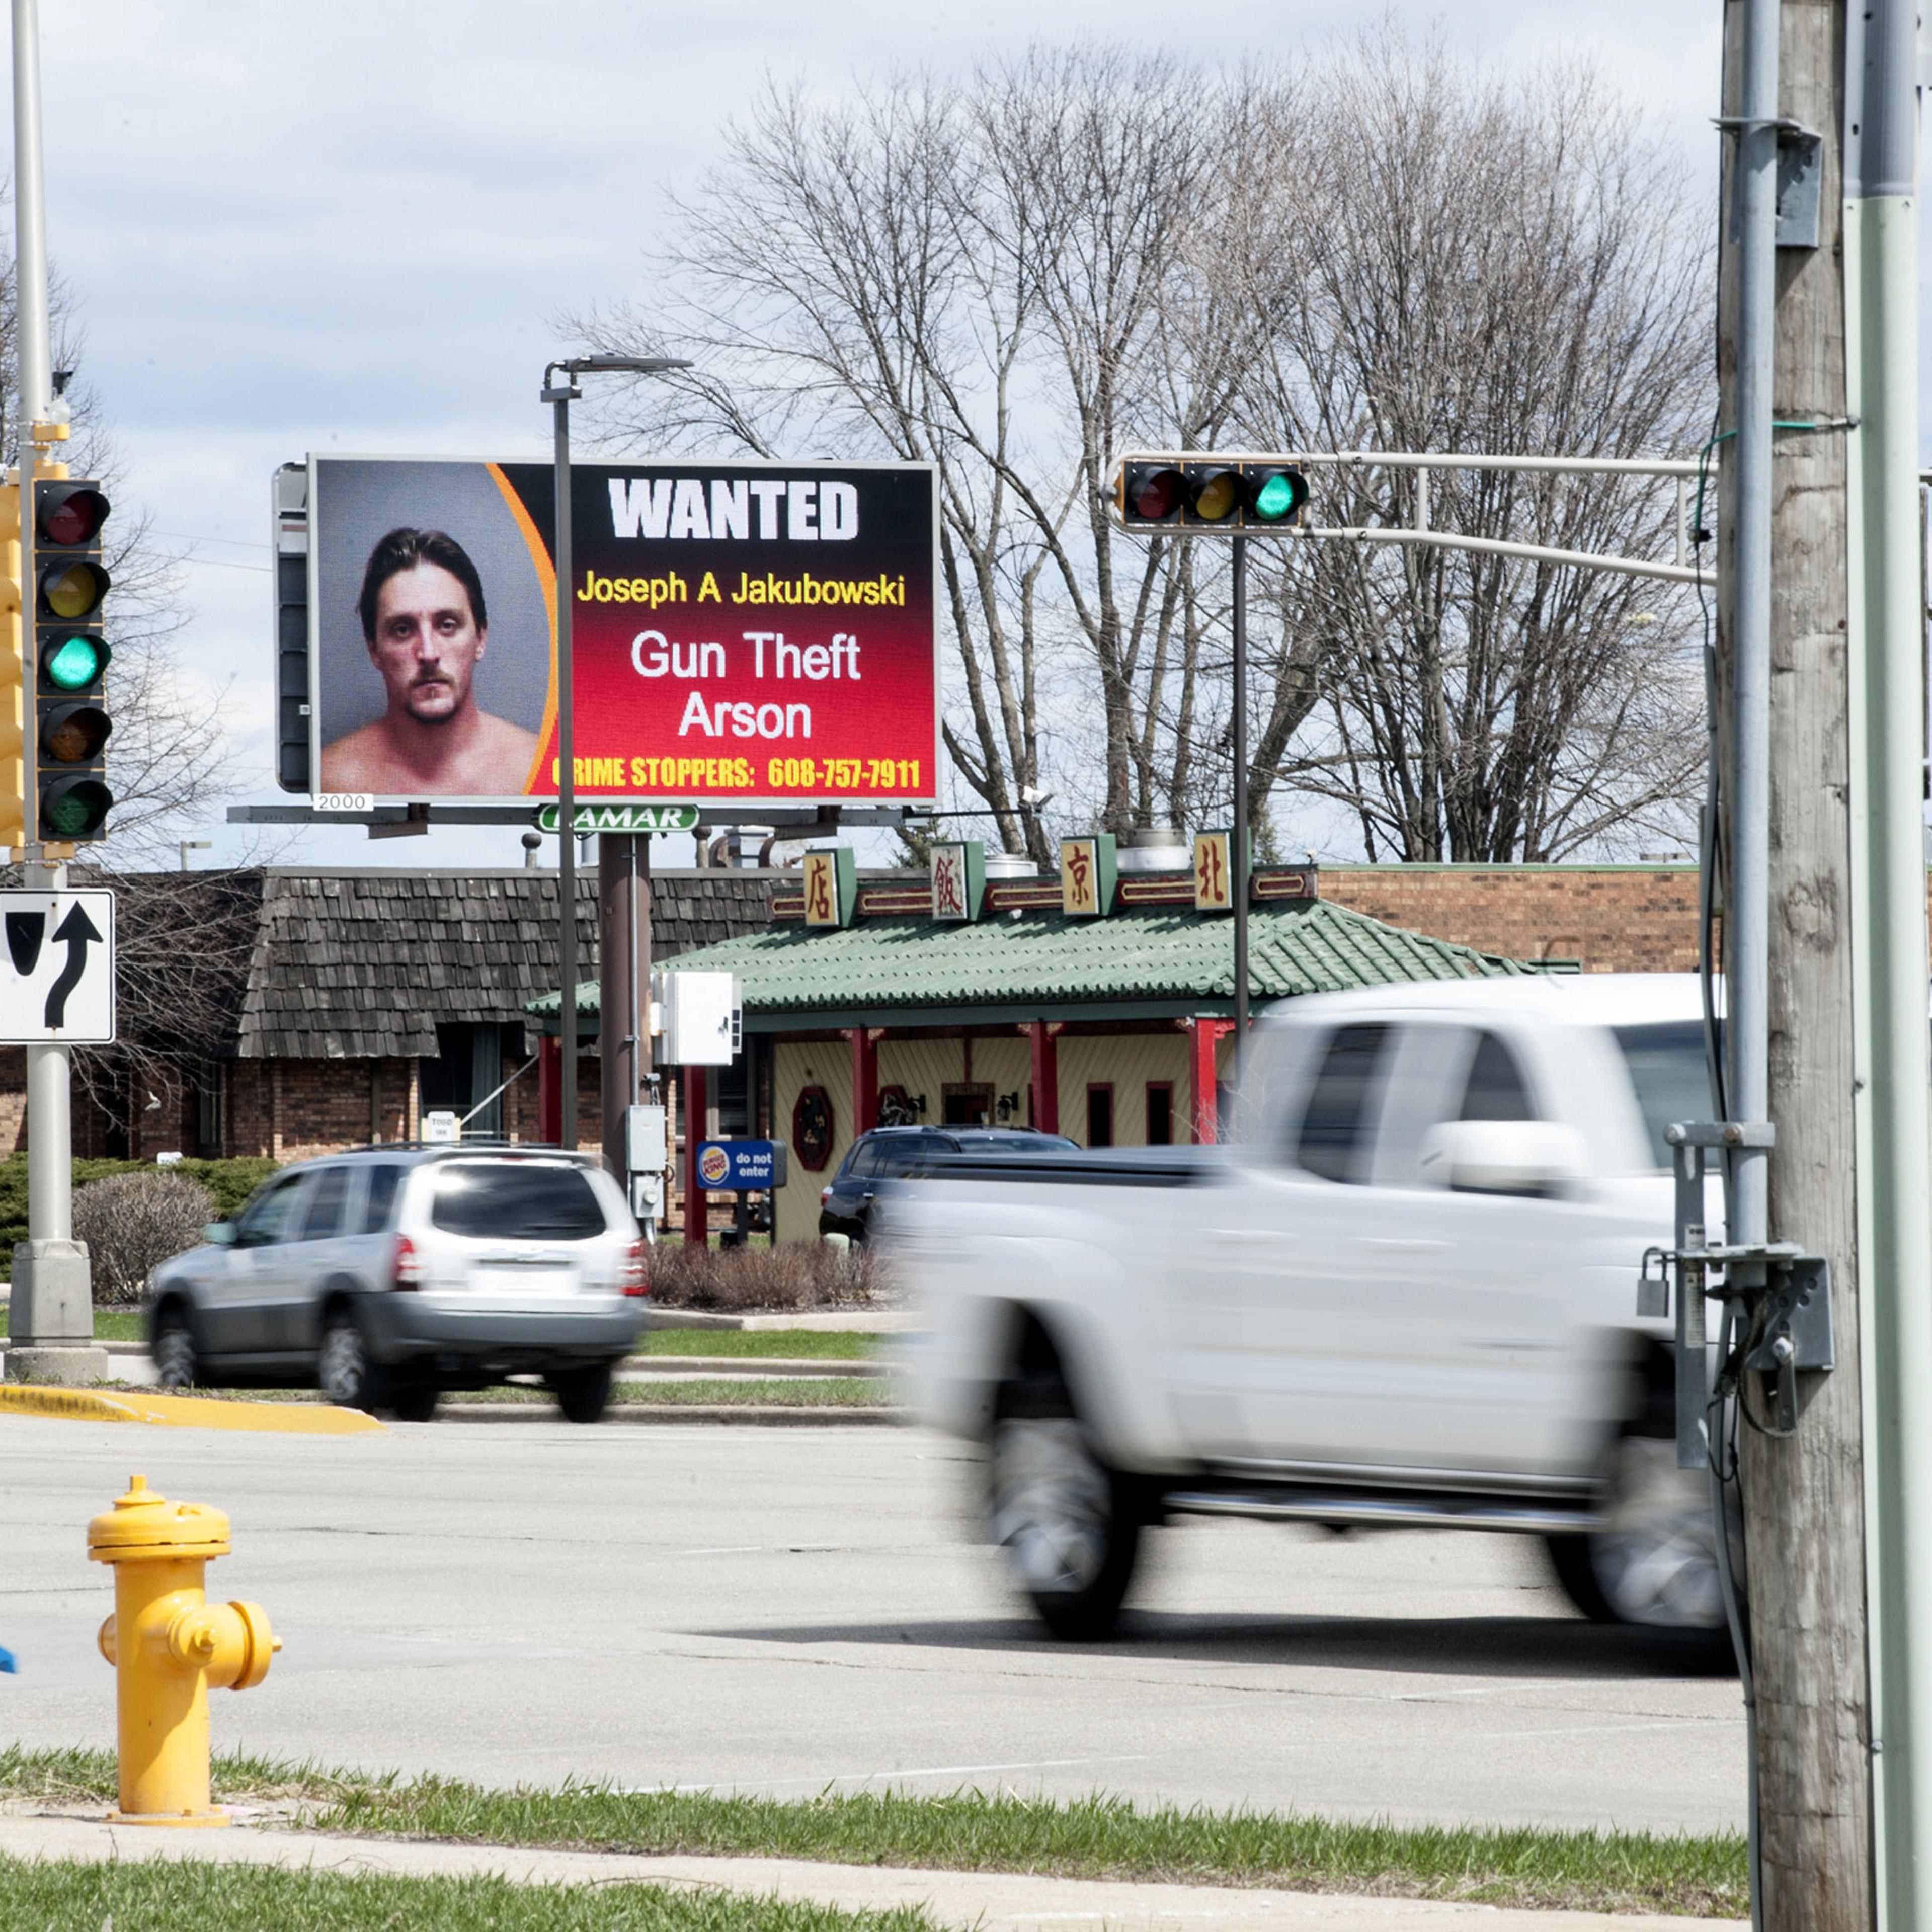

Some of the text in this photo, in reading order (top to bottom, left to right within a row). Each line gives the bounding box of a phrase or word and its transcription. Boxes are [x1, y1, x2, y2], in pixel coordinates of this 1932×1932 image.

[608, 478, 858, 540] WANTED
[577, 570, 905, 609] Joseph A Jakubowski
[631, 631, 861, 680] Gun Theft
[678, 691, 811, 738] Arson
[631, 757, 755, 788] STOPPERS:
[768, 759, 920, 788] 608-757-7911
[319, 795, 365, 810] 2000
[808, 858, 829, 920] 店
[934, 856, 962, 912] 飯
[1067, 845, 1089, 905] 京
[1198, 838, 1224, 902] 北
[736, 1153, 772, 1164] do not
[739, 1166, 769, 1177] enter
